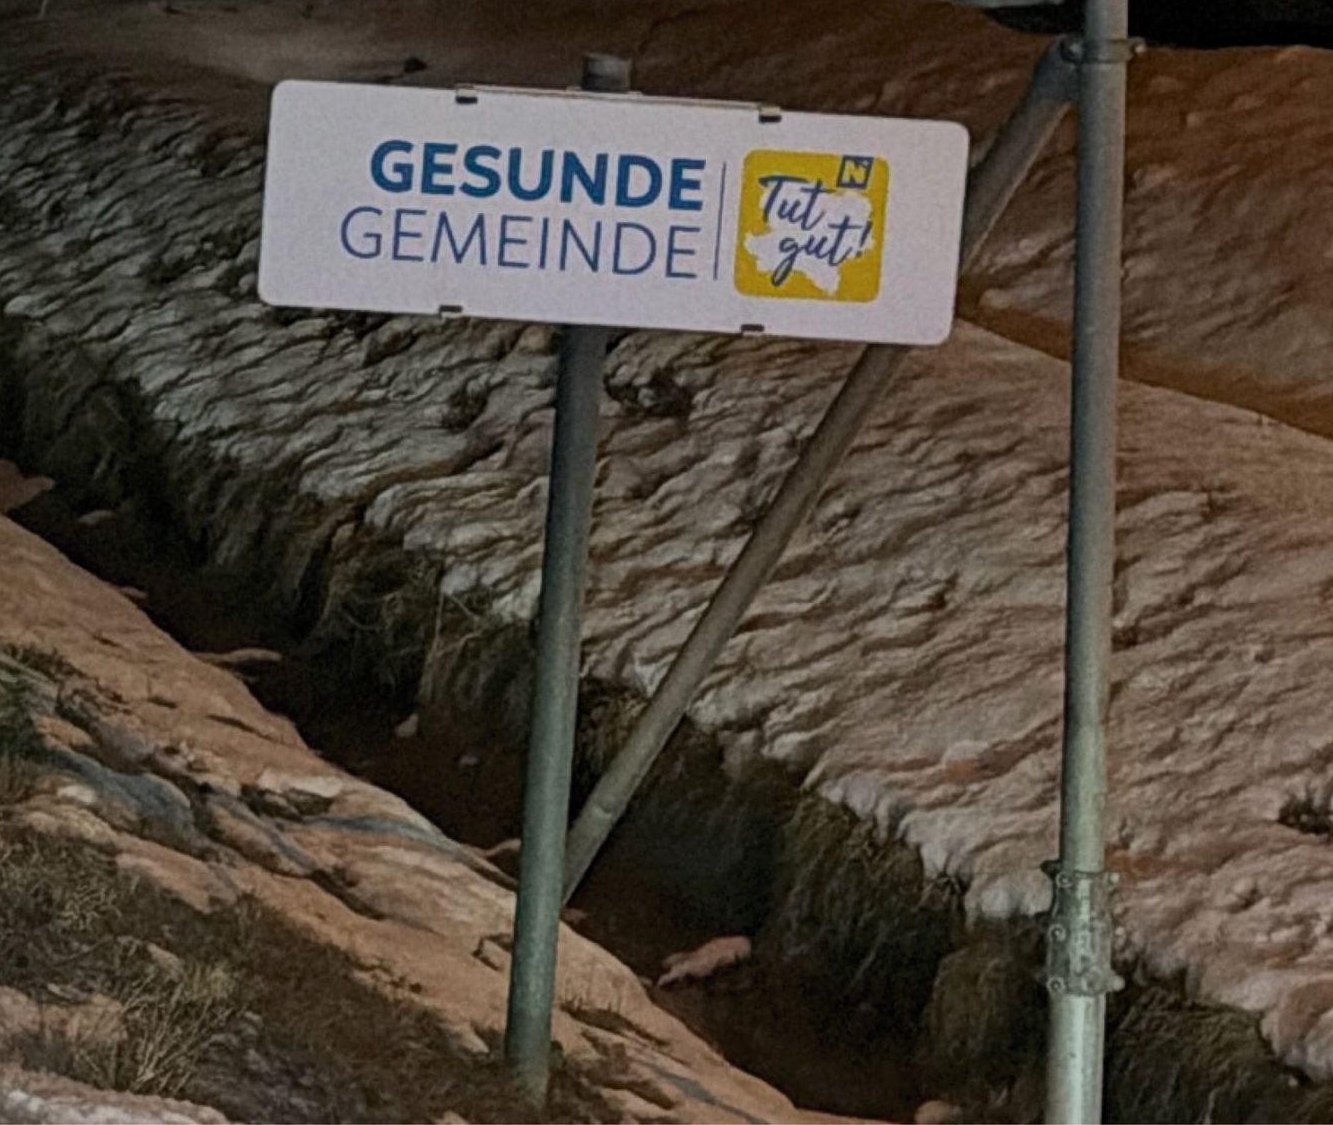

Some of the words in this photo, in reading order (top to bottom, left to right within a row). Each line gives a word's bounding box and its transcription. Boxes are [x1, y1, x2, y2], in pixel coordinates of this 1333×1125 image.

[369, 139, 707, 212] GESUNDE
[757, 175, 836, 231] Tut
[339, 205, 702, 279] GEMEINDE
[770, 215, 874, 288] gut!
